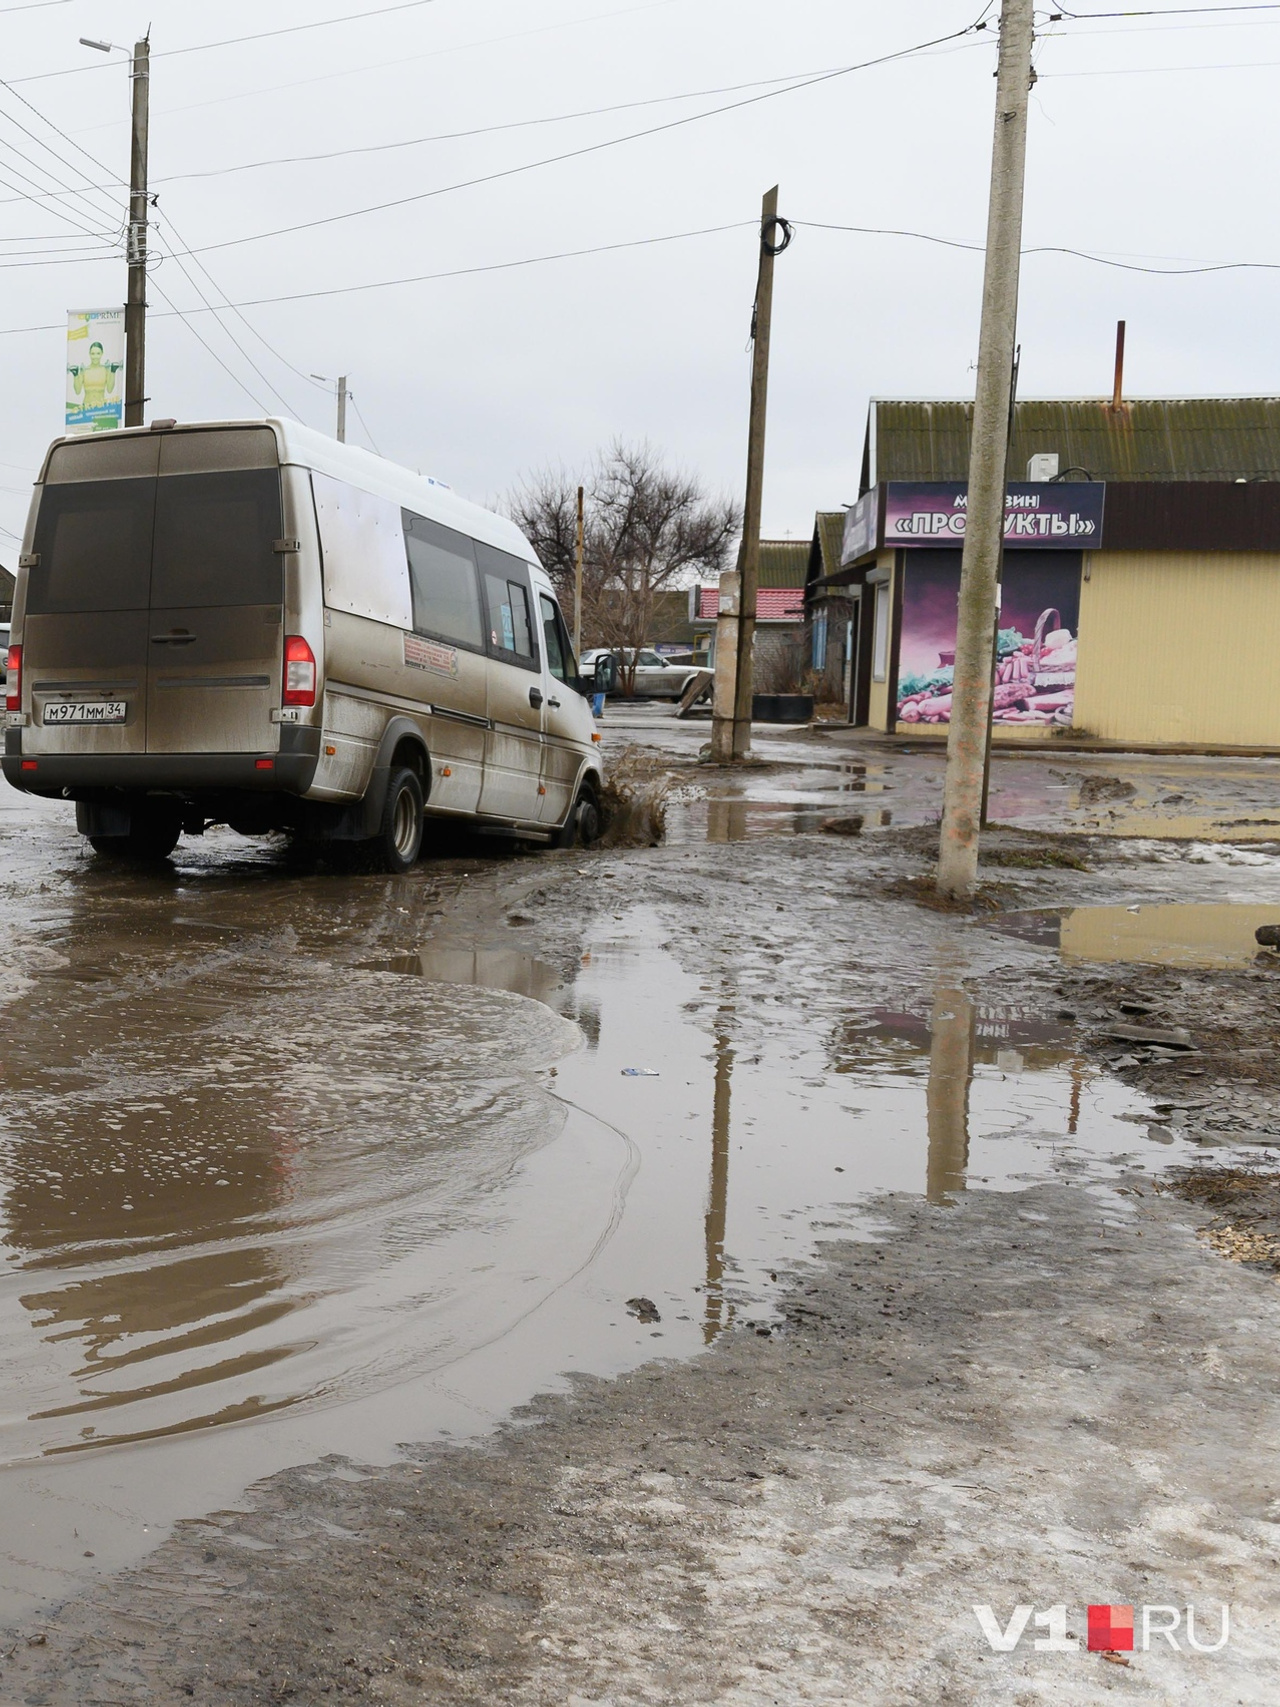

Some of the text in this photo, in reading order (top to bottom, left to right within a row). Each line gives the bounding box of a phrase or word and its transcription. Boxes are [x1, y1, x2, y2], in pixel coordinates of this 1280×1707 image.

[953, 494, 1039, 509] МЗИН
[895, 512, 1095, 535] «ПРОУКТЫ»
[49, 703, 121, 719] М971ММ 34
